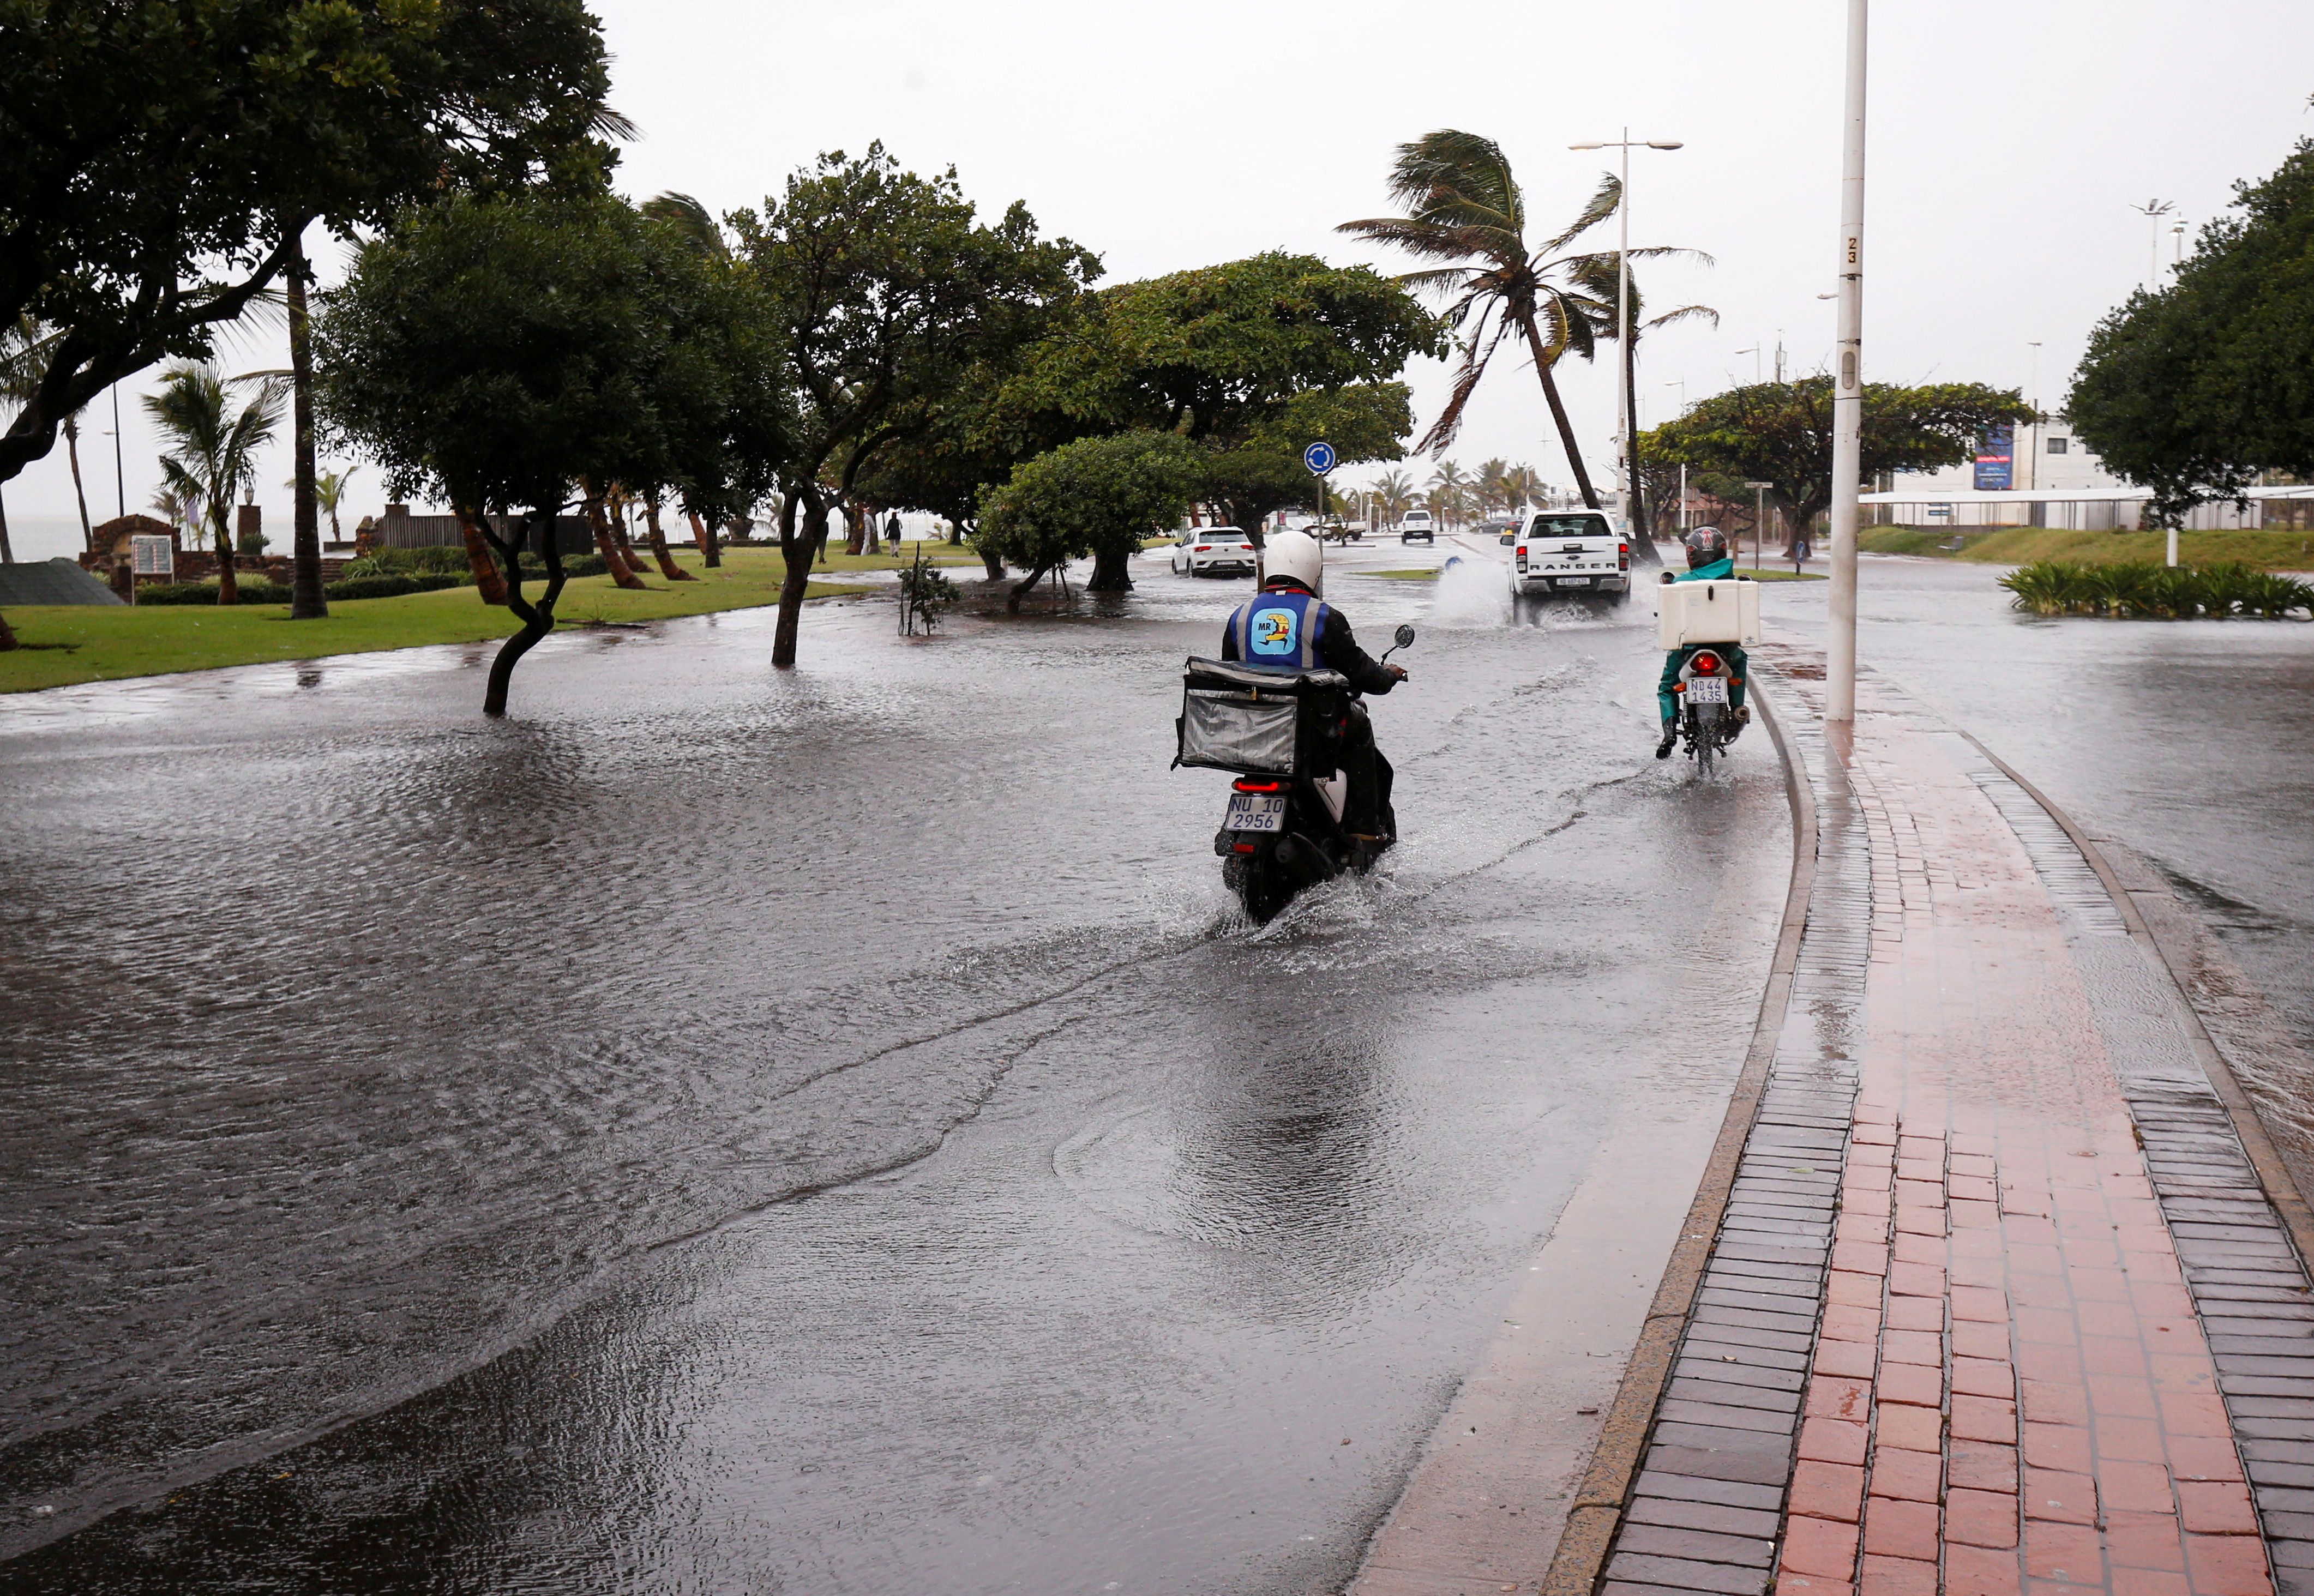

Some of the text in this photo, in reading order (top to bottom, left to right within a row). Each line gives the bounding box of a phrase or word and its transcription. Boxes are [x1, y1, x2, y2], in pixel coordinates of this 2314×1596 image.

[1691, 681, 1721, 691] ND 44
[1692, 691, 1722, 702] 1435
[1231, 798, 1283, 813] NU 10
[1233, 814, 1273, 828] 2956
